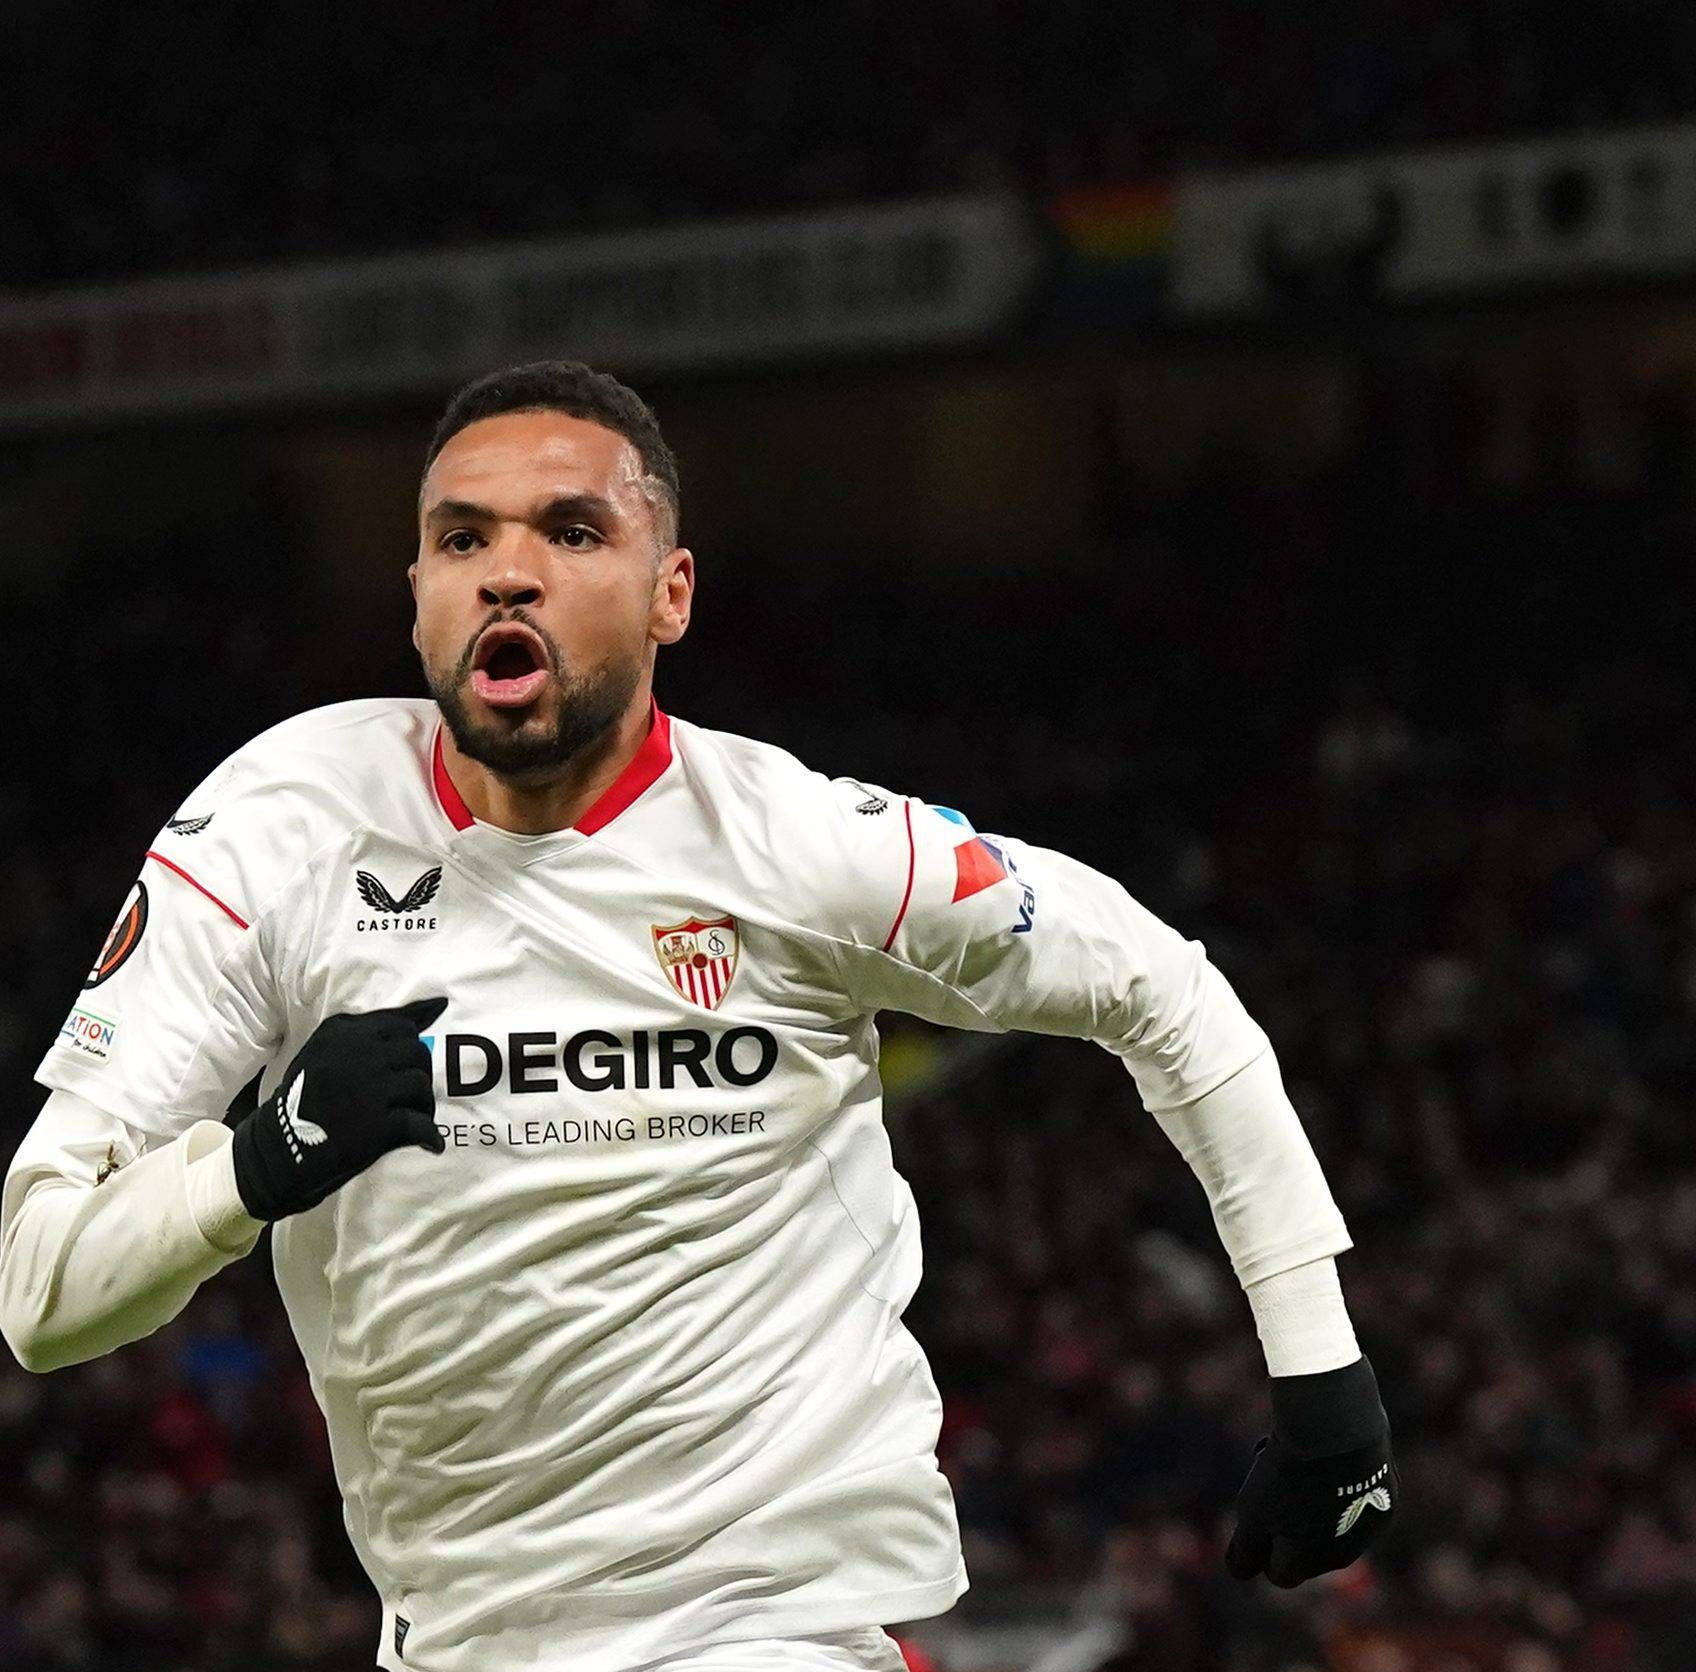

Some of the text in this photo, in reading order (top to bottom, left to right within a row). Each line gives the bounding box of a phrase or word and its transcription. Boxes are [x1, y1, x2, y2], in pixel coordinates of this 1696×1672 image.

[357, 917, 437, 932] CASTORE
[68, 1015, 115, 1046] ATION
[445, 1025, 779, 1098] DEGIRO
[436, 1111, 766, 1147] PE'S LEADING BROKER
